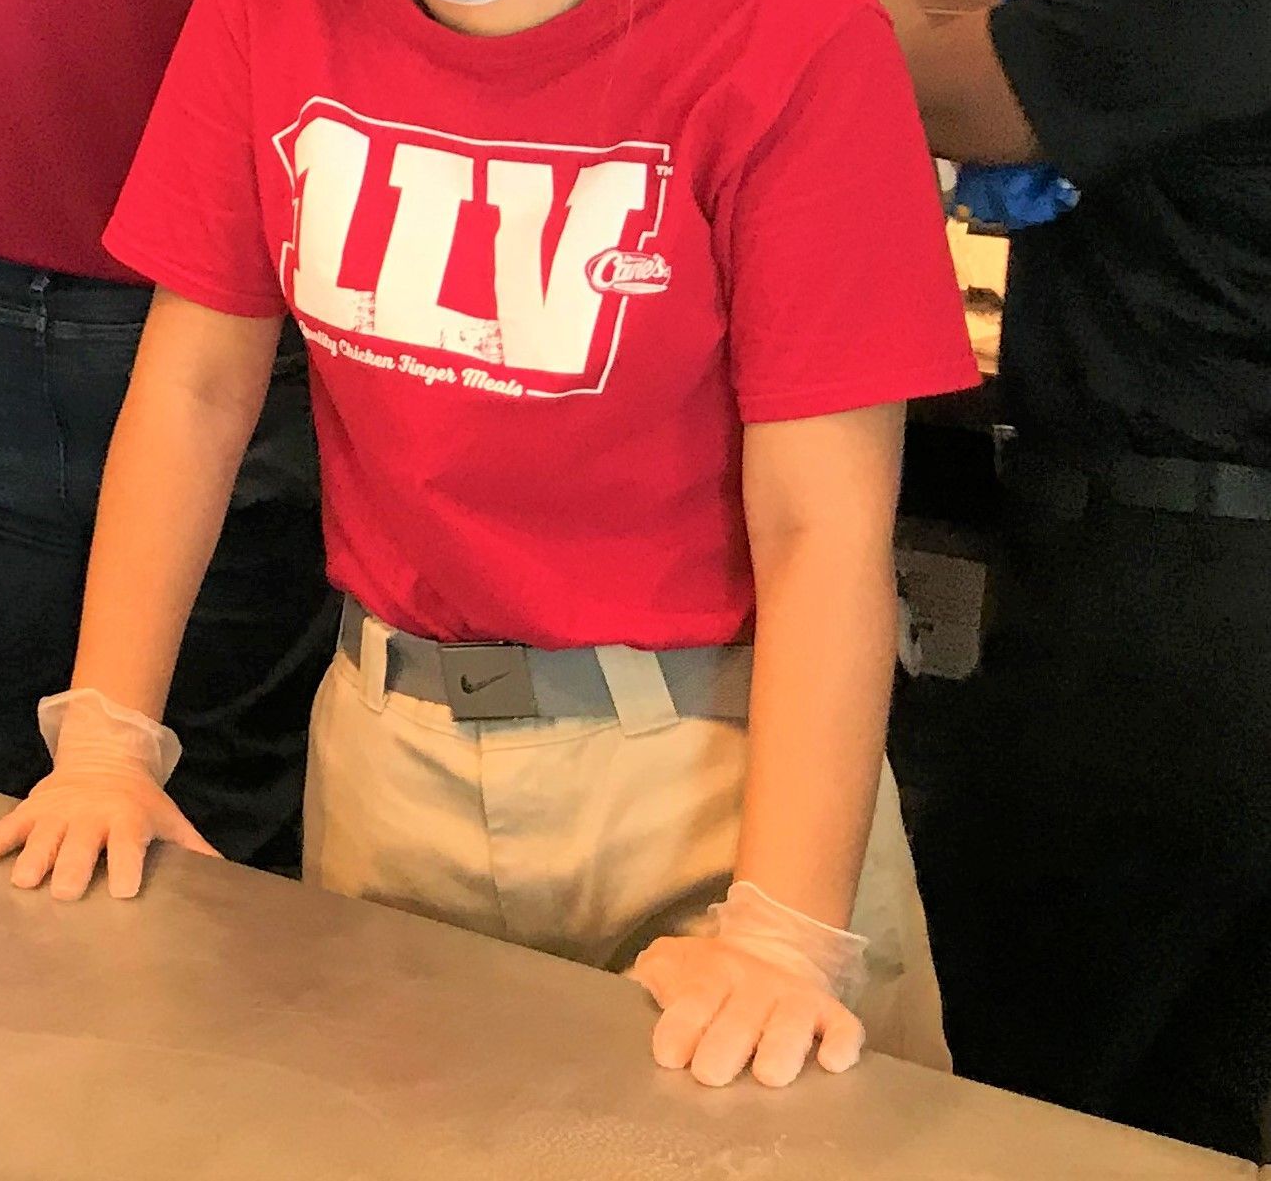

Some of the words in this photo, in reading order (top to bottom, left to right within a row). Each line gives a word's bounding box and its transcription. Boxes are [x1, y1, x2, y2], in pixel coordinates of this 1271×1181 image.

[589, 251, 669, 292] Cane's
[339, 340, 395, 370] Chicken
[398, 354, 457, 386] Finger
[461, 368, 523, 397] Meals
